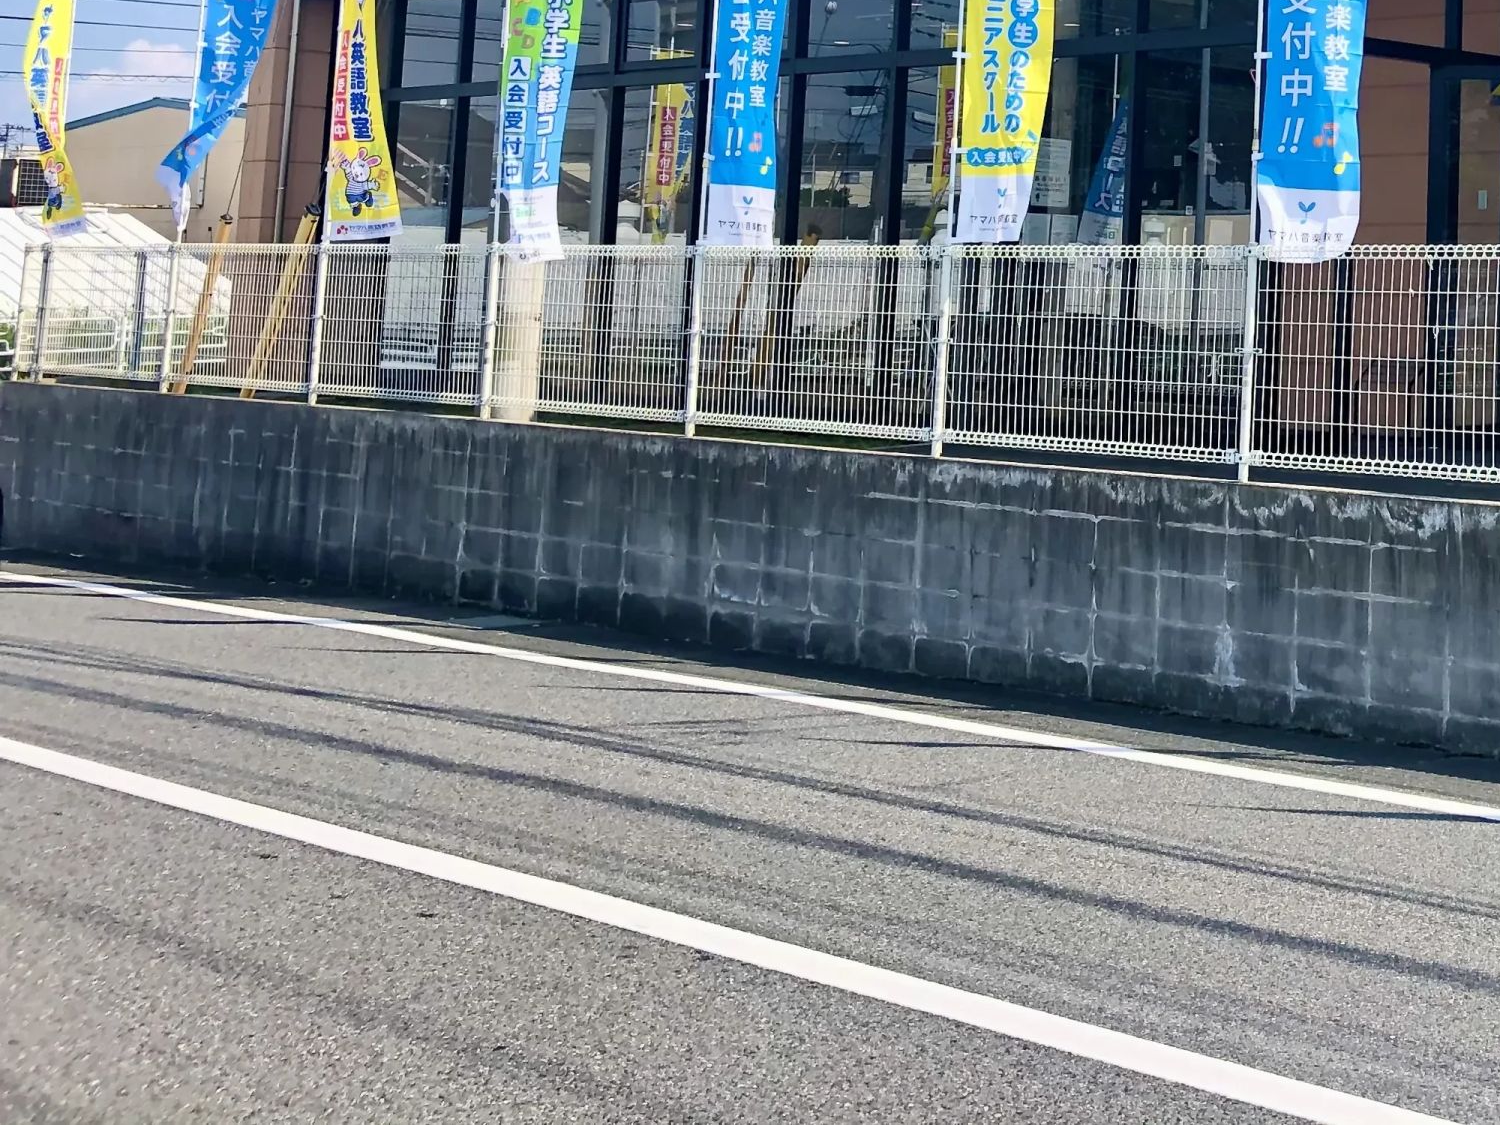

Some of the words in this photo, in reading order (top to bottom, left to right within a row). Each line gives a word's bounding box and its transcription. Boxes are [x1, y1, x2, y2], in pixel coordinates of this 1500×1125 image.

[503, 57, 529, 181] 入会受付中
[532, 64, 563, 185] 英語コース
